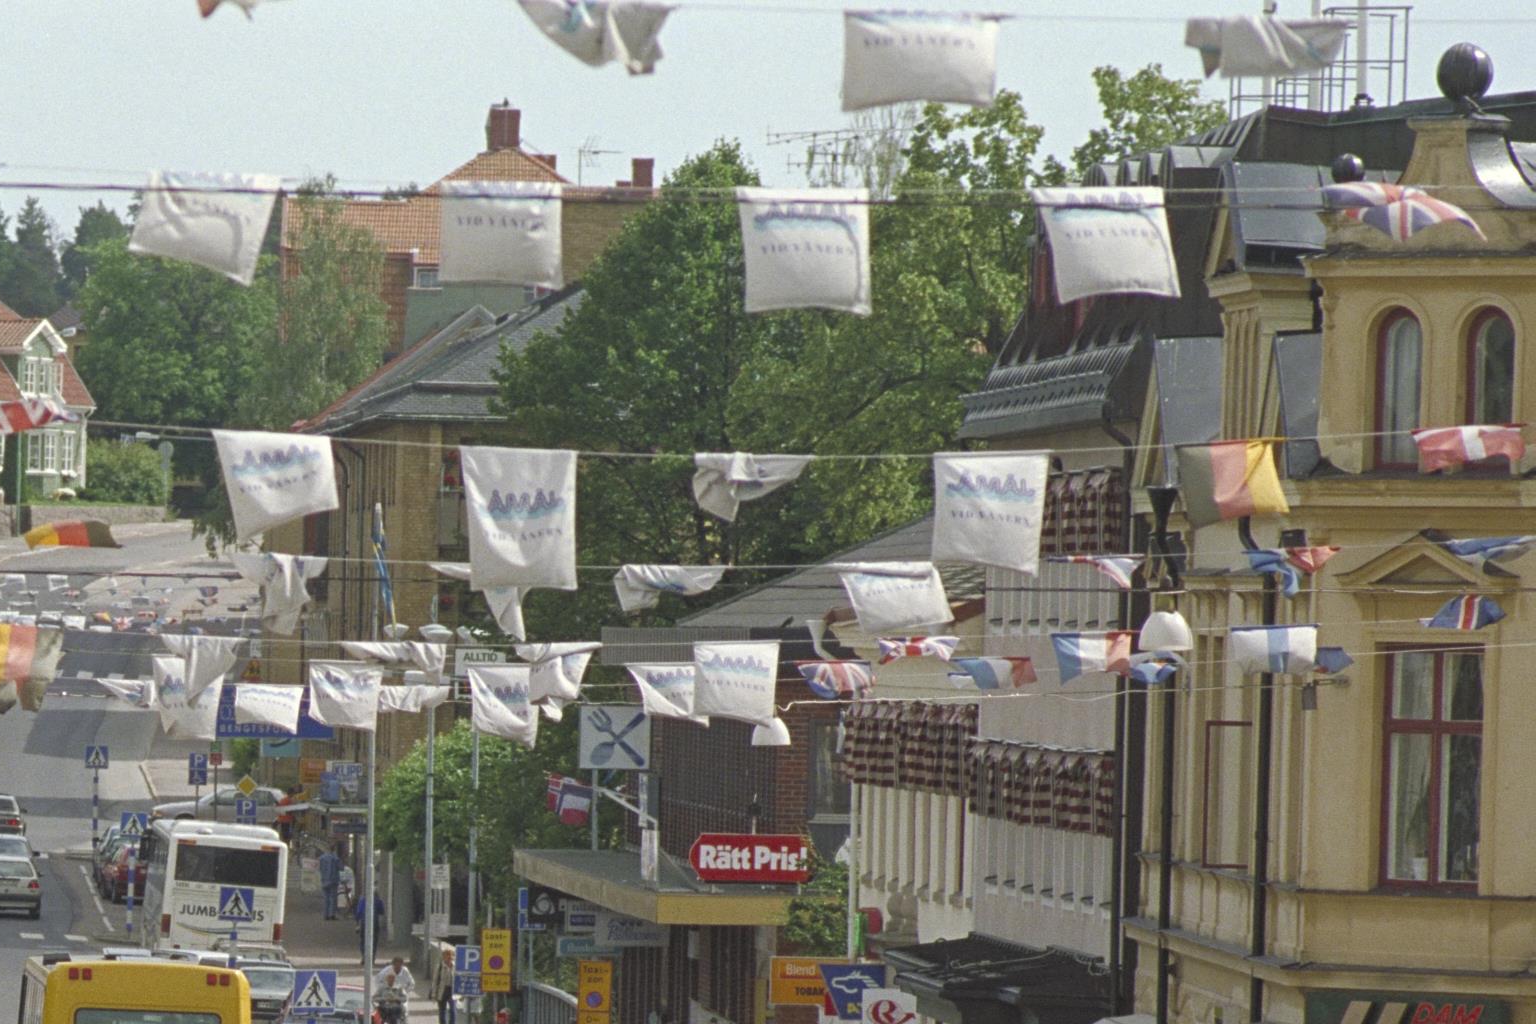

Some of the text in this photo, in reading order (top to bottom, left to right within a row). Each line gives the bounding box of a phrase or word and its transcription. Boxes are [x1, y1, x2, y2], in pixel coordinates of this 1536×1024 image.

[960, 472, 1037, 499] ÅMÅL
[487, 487, 566, 513] ÅMÅL
[242, 800, 253, 816] P
[699, 844, 752, 870] Rätt
[465, 949, 480, 970] P
[785, 963, 817, 976] Blend
[795, 986, 824, 996] TOBAK
